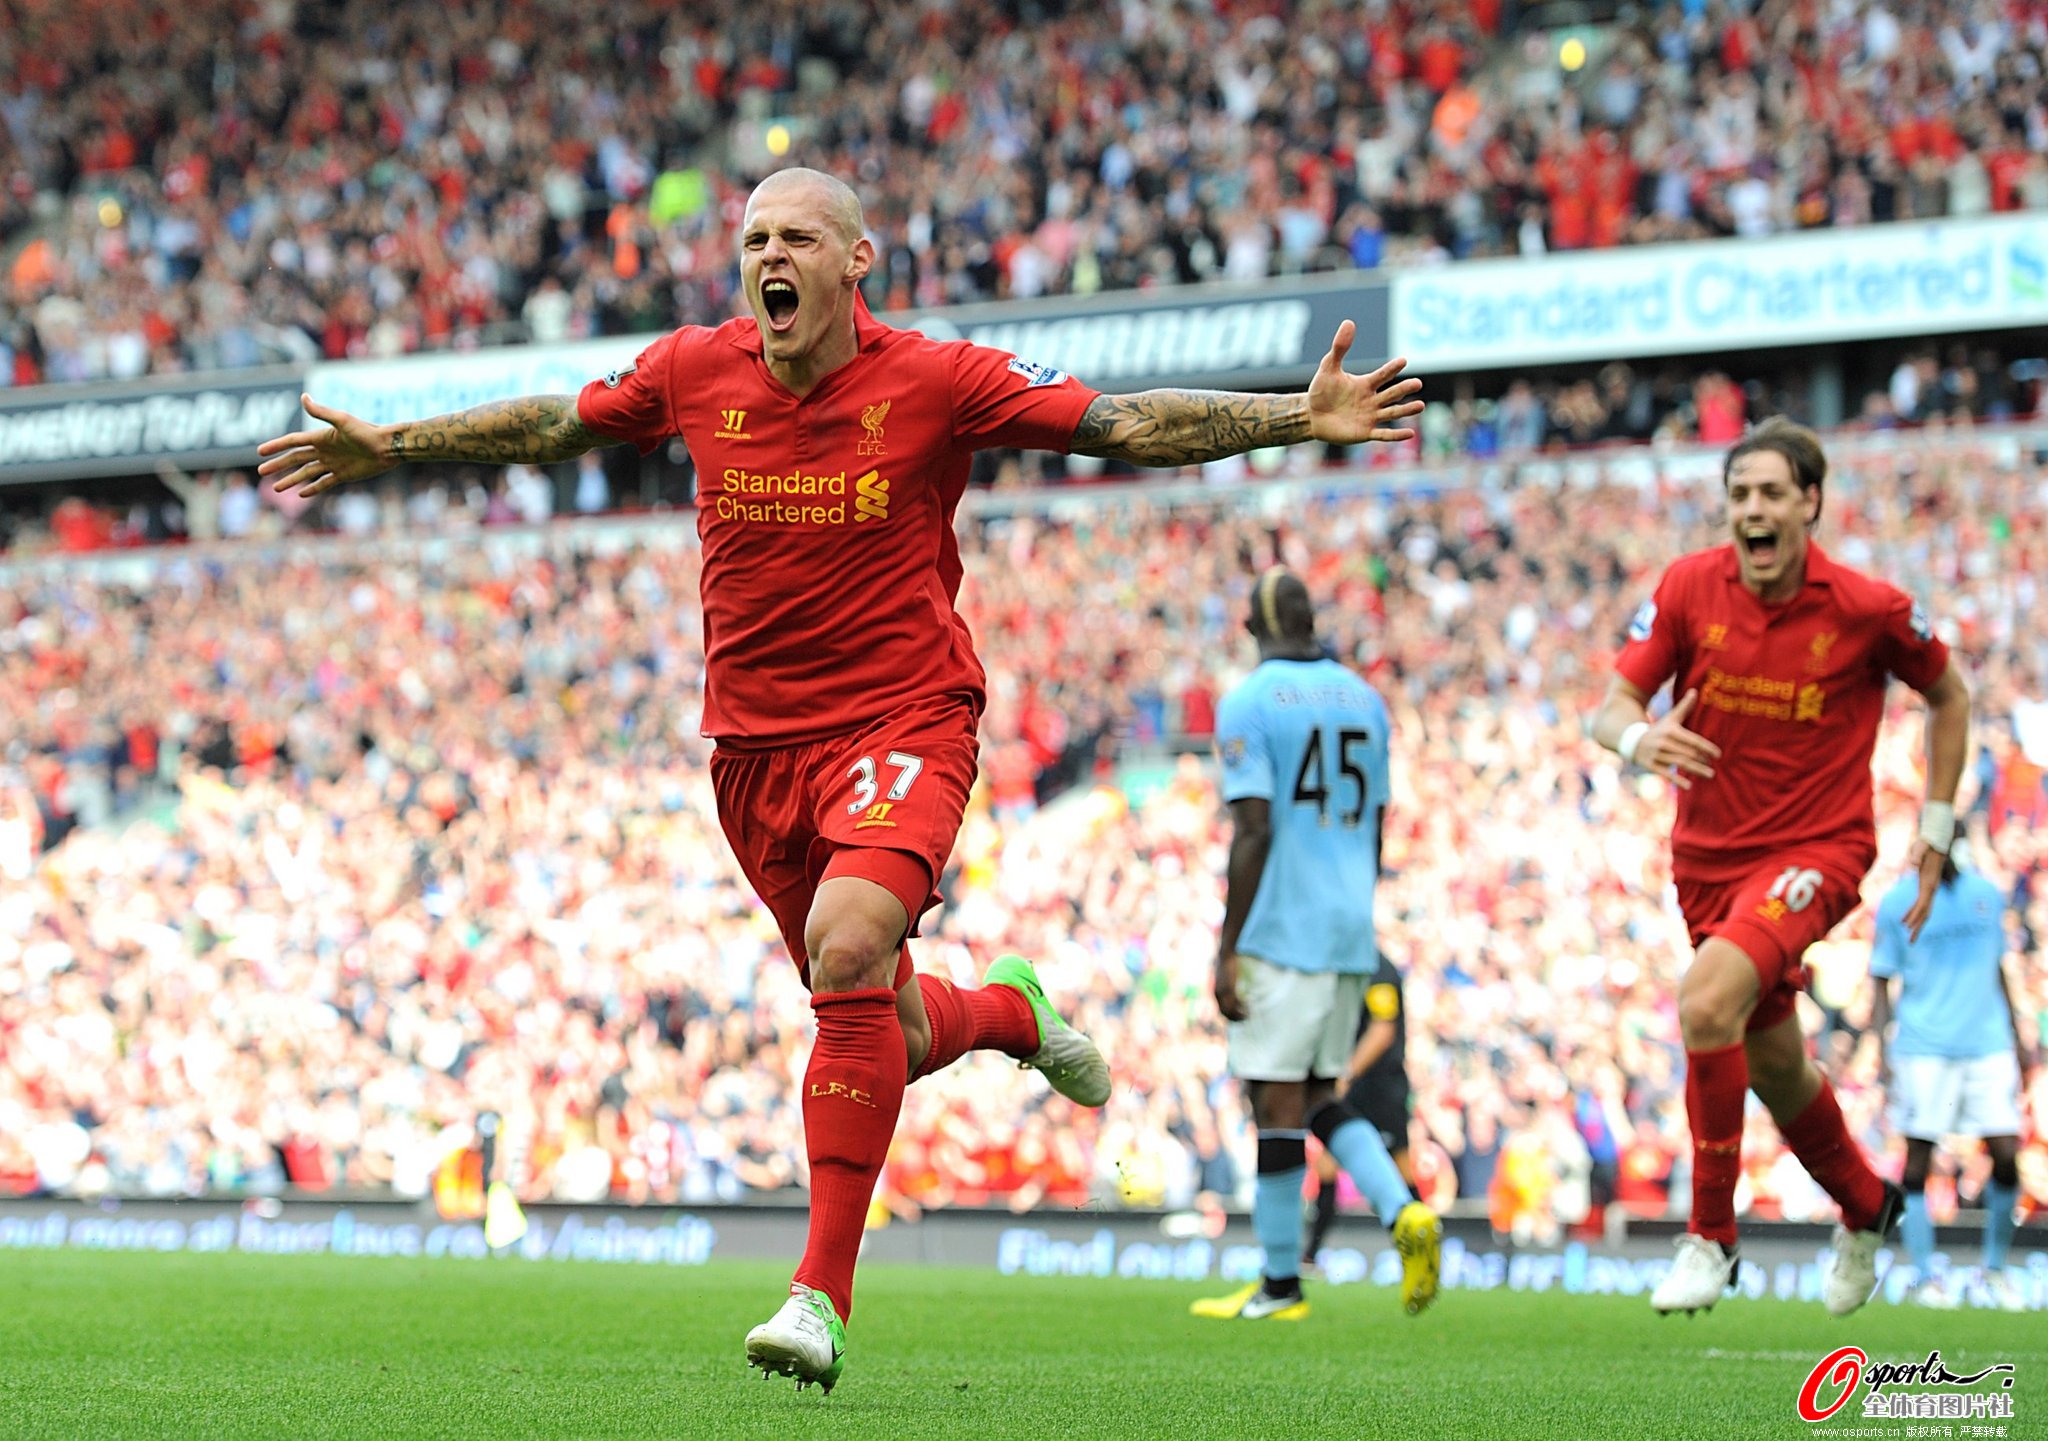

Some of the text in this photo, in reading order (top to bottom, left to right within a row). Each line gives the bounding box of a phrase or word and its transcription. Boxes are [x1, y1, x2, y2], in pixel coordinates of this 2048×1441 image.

[1408, 240, 1994, 350] Standard Chartered
[723, 468, 846, 496] Standard
[716, 496, 846, 525] Chartered
[847, 750, 924, 816] 37
[1293, 727, 1368, 828] 45
[1766, 865, 1824, 914] 16
[997, 1227, 1115, 1278] Find
